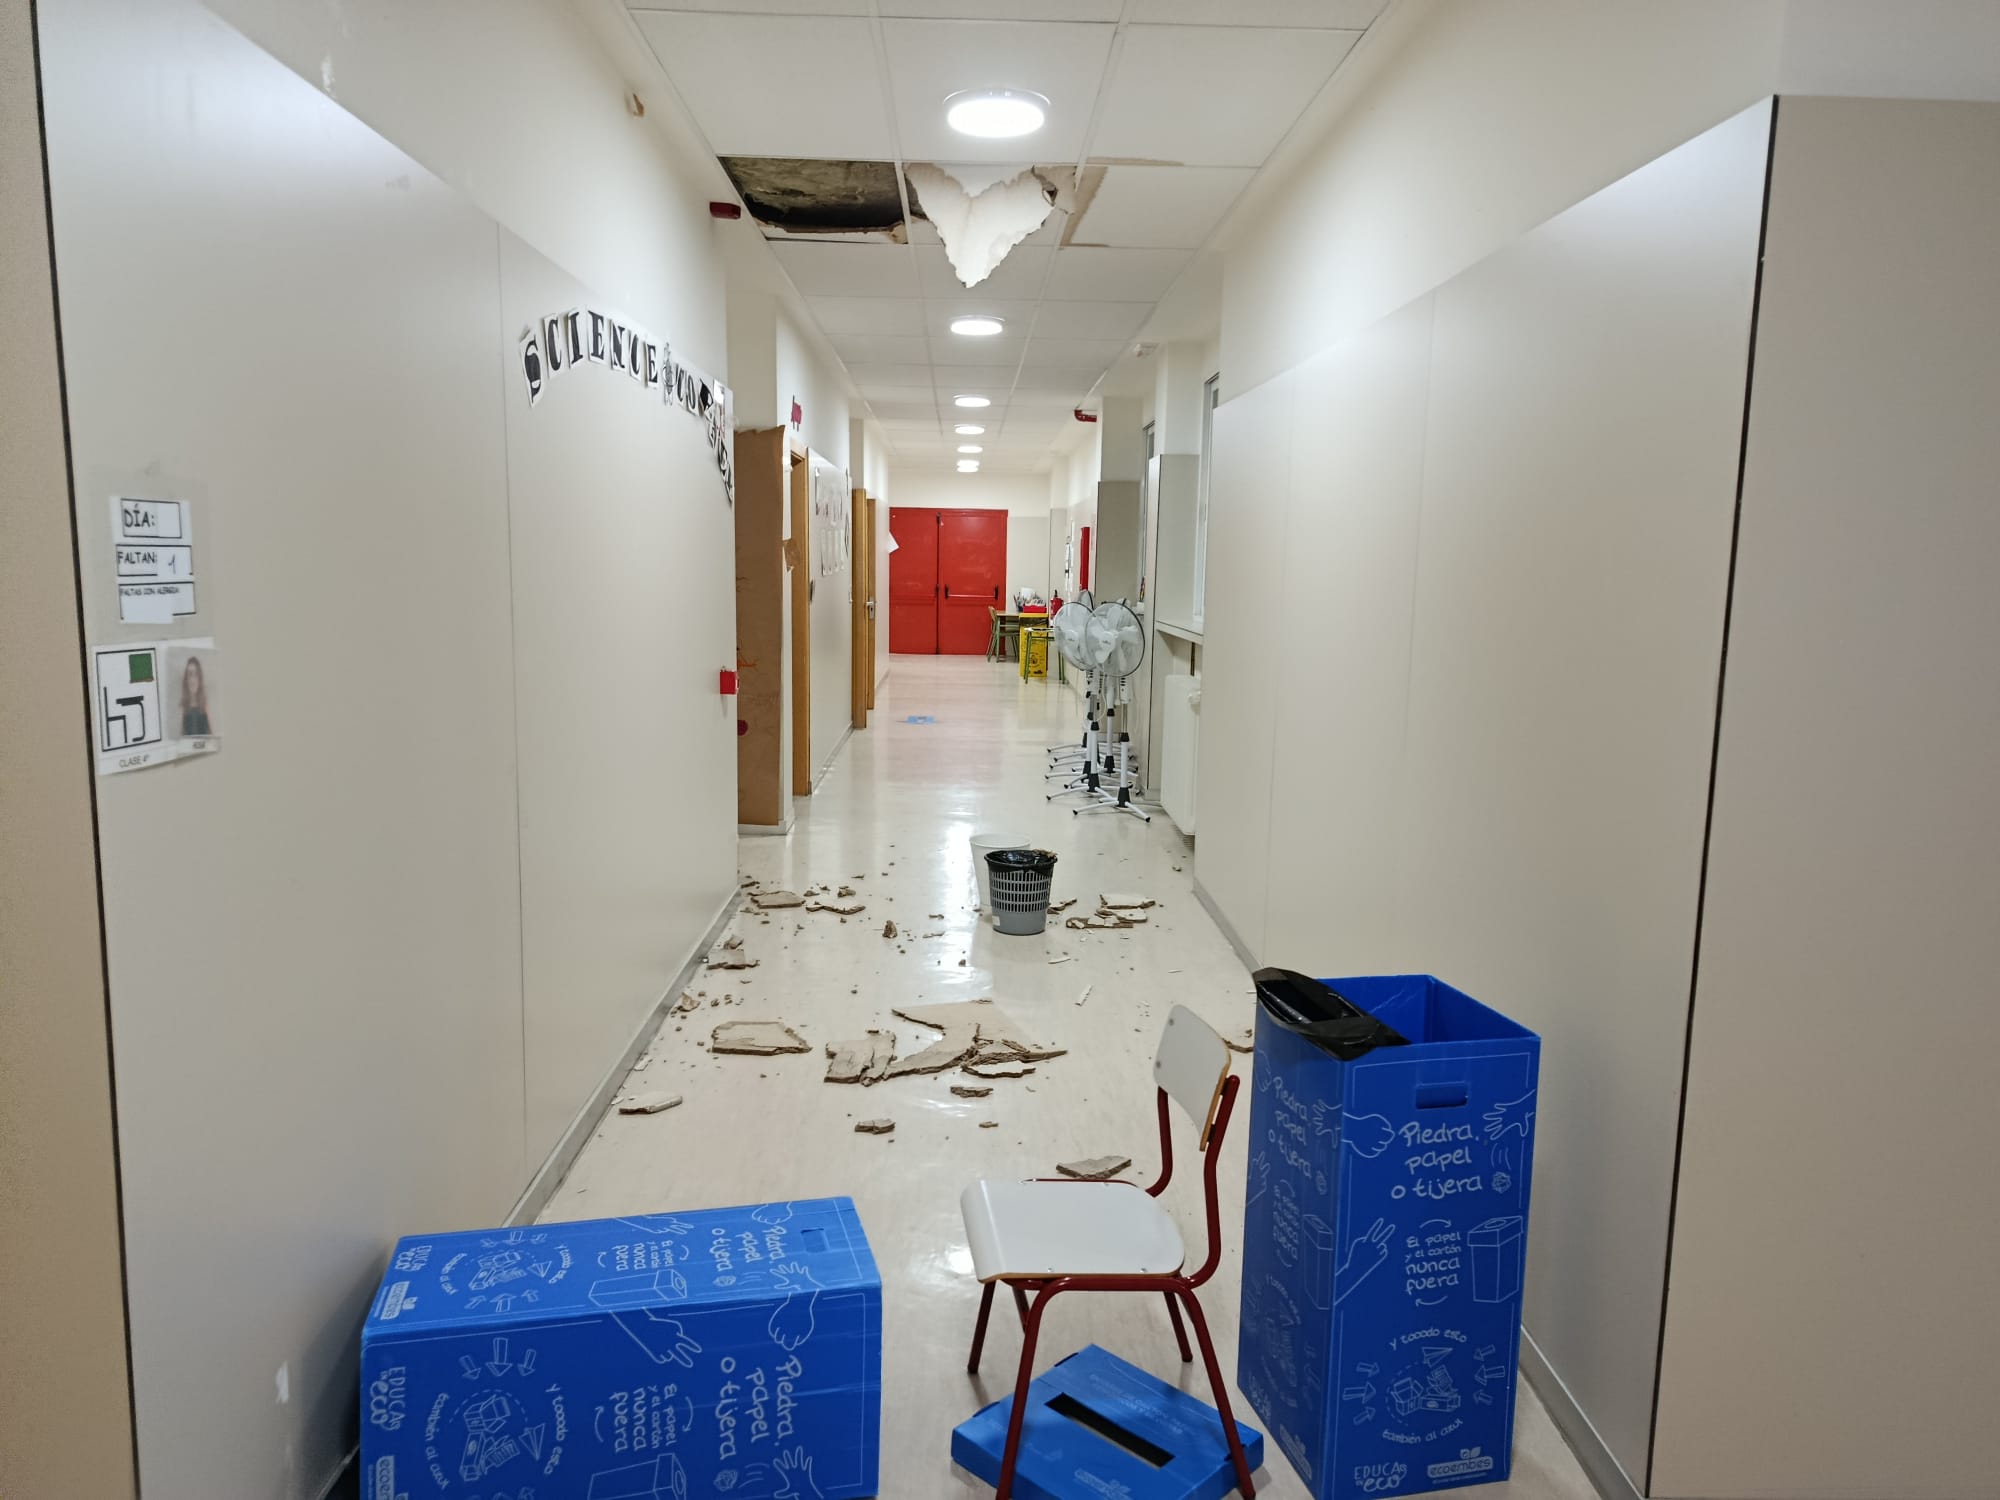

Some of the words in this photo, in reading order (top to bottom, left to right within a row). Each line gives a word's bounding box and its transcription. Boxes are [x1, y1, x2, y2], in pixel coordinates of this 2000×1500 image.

[524, 310, 658, 403] SCIENCE
[123, 503, 156, 528] DÍA:
[117, 551, 157, 564] FALTAN:
[1404, 1147, 1472, 1175] papel
[1391, 1184, 1406, 1199] o
[1412, 1176, 1483, 1199] tijera
[711, 1227, 726, 1236] o
[1407, 1236, 1420, 1248] El
[1425, 1232, 1462, 1247] papel
[611, 1244, 630, 1272] fuera
[632, 1242, 647, 1271] nunca
[709, 1237, 734, 1272] tijera
[735, 1231, 764, 1263] papel
[1415, 1249, 1425, 1257] el
[1428, 1245, 1462, 1257] cartón
[1406, 1257, 1461, 1275] nunca
[1406, 1274, 1459, 1295] fuera
[1443, 1329, 1468, 1343] esto
[720, 1356, 736, 1374] o
[370, 1380, 389, 1425] eco
[651, 1396, 662, 1408] el
[663, 1383, 677, 1399] El
[424, 1392, 450, 1442] también
[745, 1367, 770, 1443] papel
[609, 1391, 629, 1453] fuera
[633, 1387, 647, 1452] nunca
[651, 1411, 663, 1449] cartón
[663, 1405, 677, 1447] papel
[715, 1381, 741, 1461] tijera
[1382, 1429, 1421, 1444] también
[1425, 1432, 1437, 1442] al
[1440, 1418, 1464, 1436] azul
[425, 1446, 438, 1461] al
[544, 1446, 562, 1475] esto
[1429, 1458, 1492, 1477] ecoembes
[1363, 1475, 1400, 1492] eco
